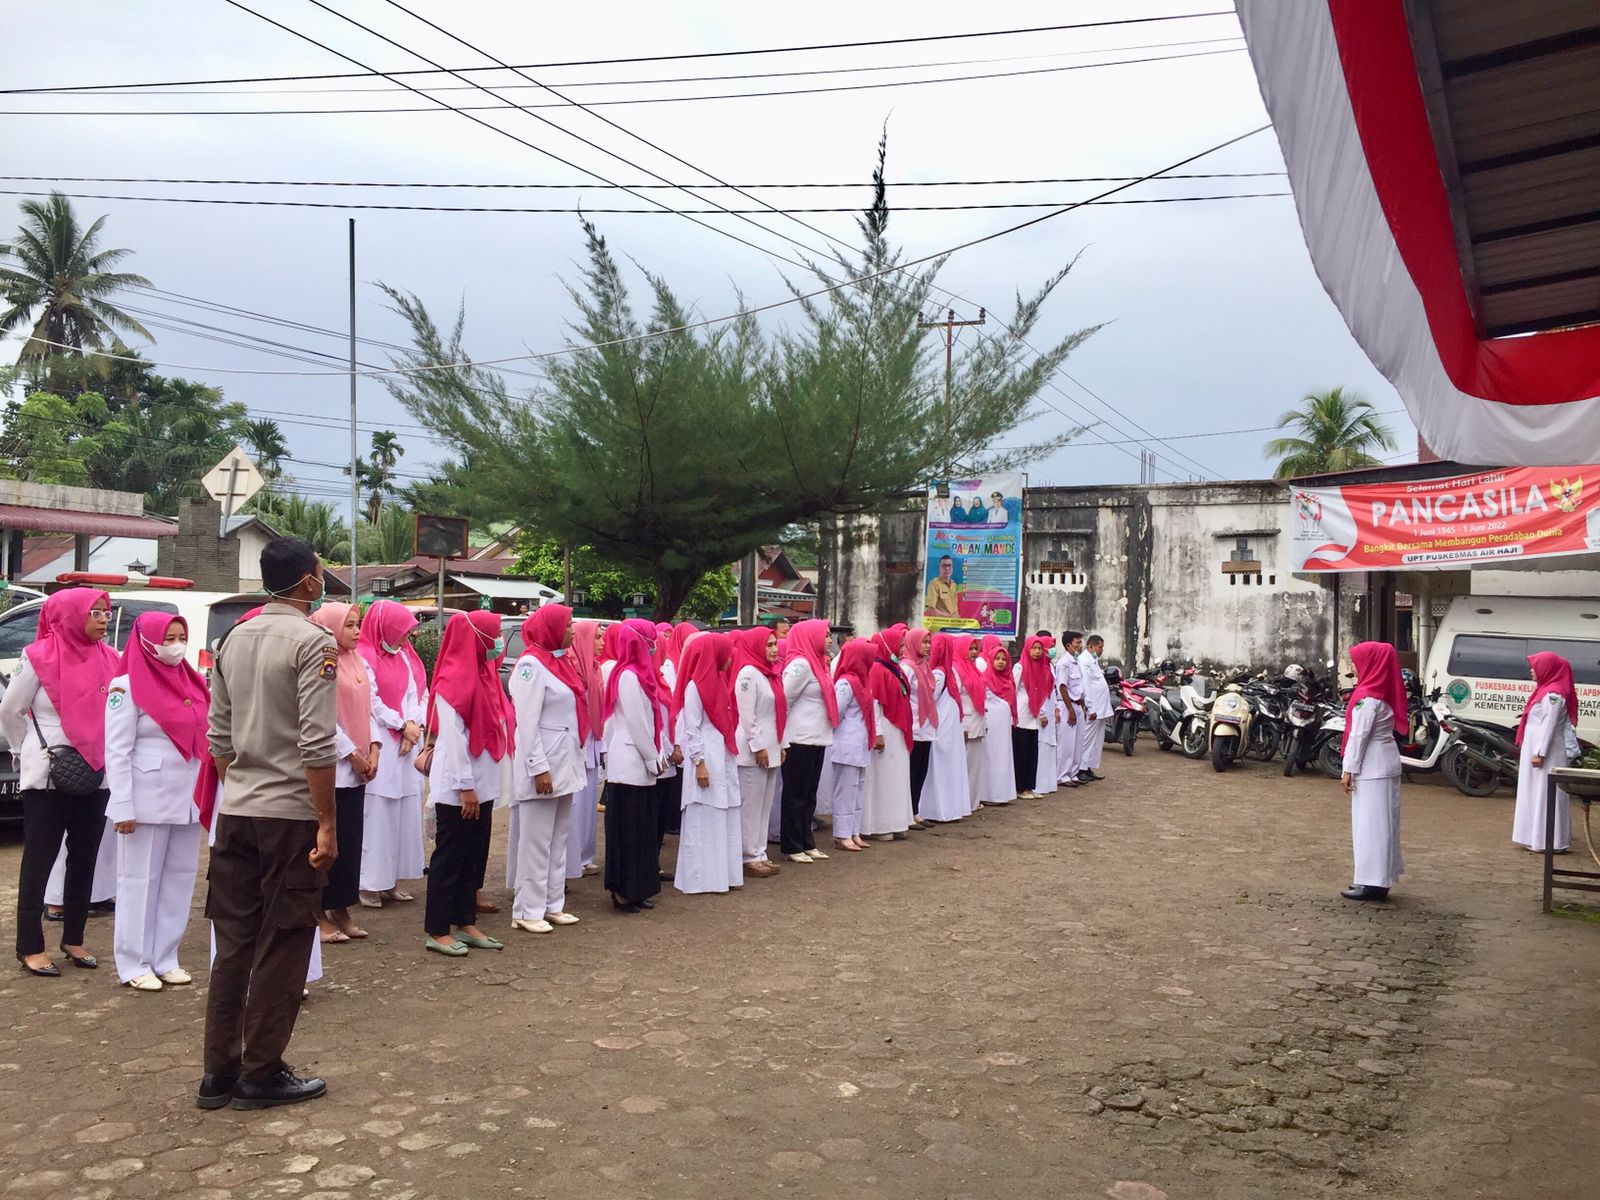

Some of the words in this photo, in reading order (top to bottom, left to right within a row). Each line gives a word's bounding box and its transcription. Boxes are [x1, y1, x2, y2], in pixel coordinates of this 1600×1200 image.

[1406, 482, 1449, 493] Selamat
[1452, 477, 1475, 488] Hari
[1479, 474, 1505, 484] Lahir
[1371, 484, 1548, 528] PANCASILA
[1420, 528, 1435, 537] Juni
[1437, 526, 1456, 535] 1945
[1470, 523, 1486, 532] Juni
[1488, 521, 1507, 530] 2022
[1363, 543, 1395, 554] Bangkit
[1397, 541, 1433, 551] Bersama
[1435, 536, 1487, 547] Membangun
[1488, 531, 1534, 543] Peradaban
[1536, 527, 1563, 538] Dunia
[1407, 555, 1424, 563] UPT
[1426, 551, 1478, 561] PUSKESMAS
[1480, 549, 1495, 557] AIR
[1498, 546, 1518, 554] HAJI
[1475, 681, 1517, 692] PUSKESMAS
[1474, 692, 1504, 702] DITJEN
[1506, 694, 1526, 703] BINA
